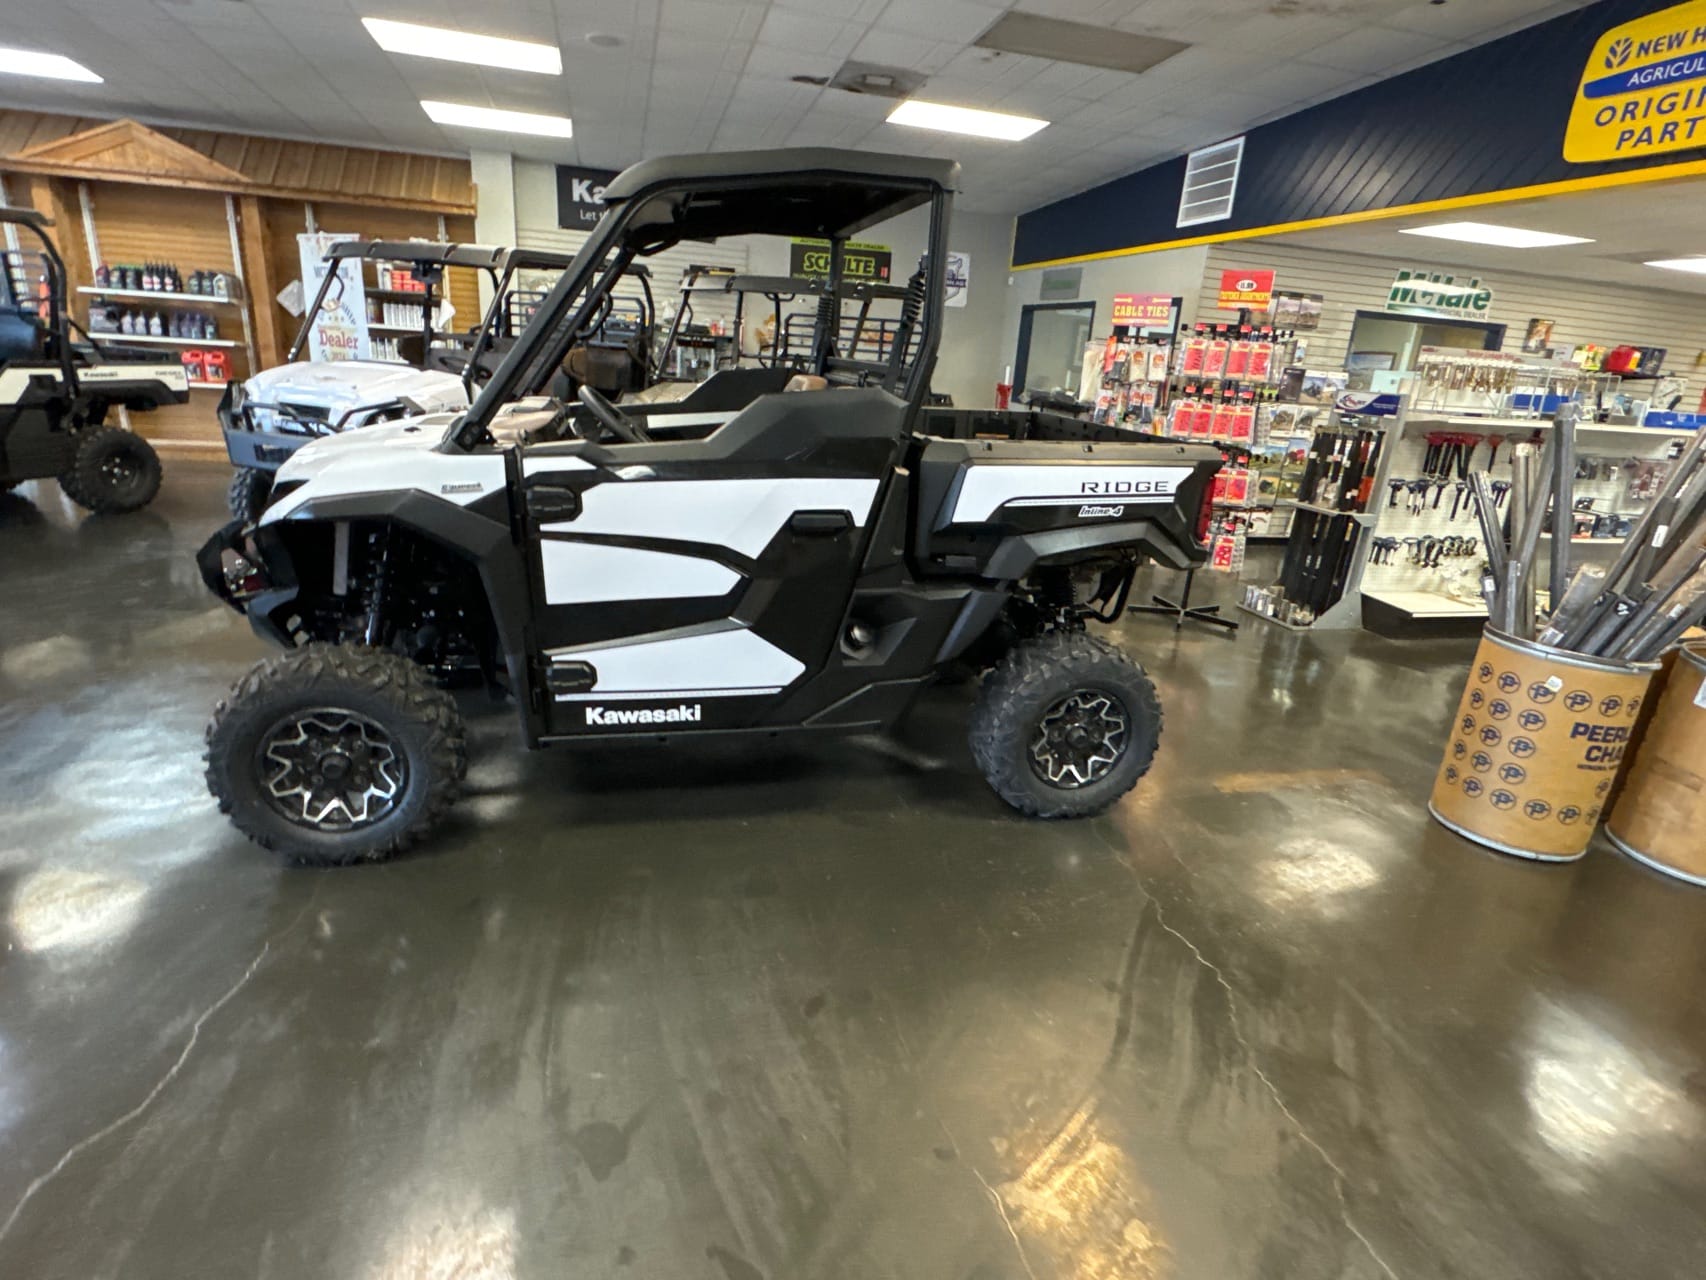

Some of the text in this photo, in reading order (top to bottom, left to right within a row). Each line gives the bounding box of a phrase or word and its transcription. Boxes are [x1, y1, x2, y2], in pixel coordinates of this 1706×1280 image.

[1636, 30, 1688, 58] NEW
[580, 209, 597, 221] Let
[803, 252, 875, 276] SCHLTE
[1114, 305, 1169, 318] CABLE TIES
[320, 328, 359, 349] Dealer
[1081, 481, 1169, 493] RIDGE
[585, 704, 701, 725] Kawasaki
